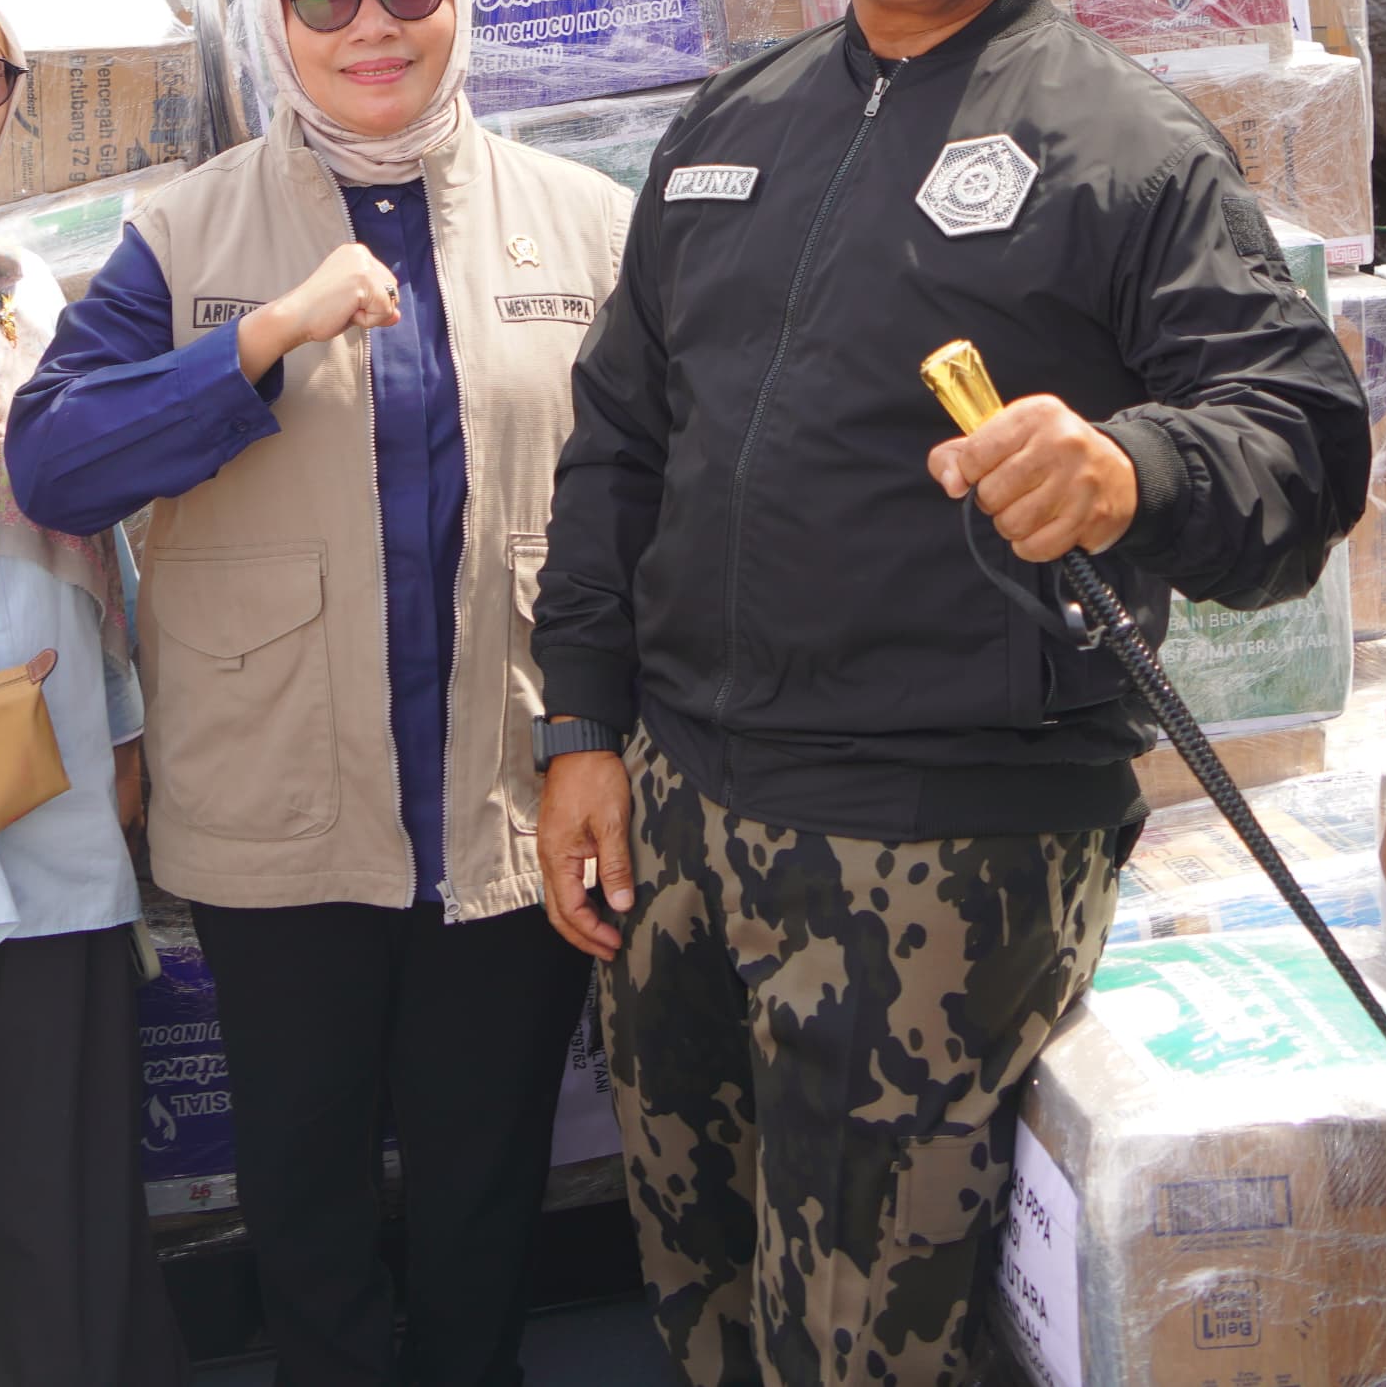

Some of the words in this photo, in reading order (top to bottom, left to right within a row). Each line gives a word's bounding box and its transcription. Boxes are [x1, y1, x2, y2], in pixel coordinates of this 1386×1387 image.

[1151, 14, 1211, 30] Formula
[71, 146, 90, 167] 72
[672, 170, 749, 194] IPUNK
[202, 302, 259, 323] ARIFA
[504, 299, 558, 318] MENTERI
[562, 299, 591, 321] PPPA
[1024, 1187, 1052, 1250] PPPA
[1215, 1320, 1253, 1340] Beli
